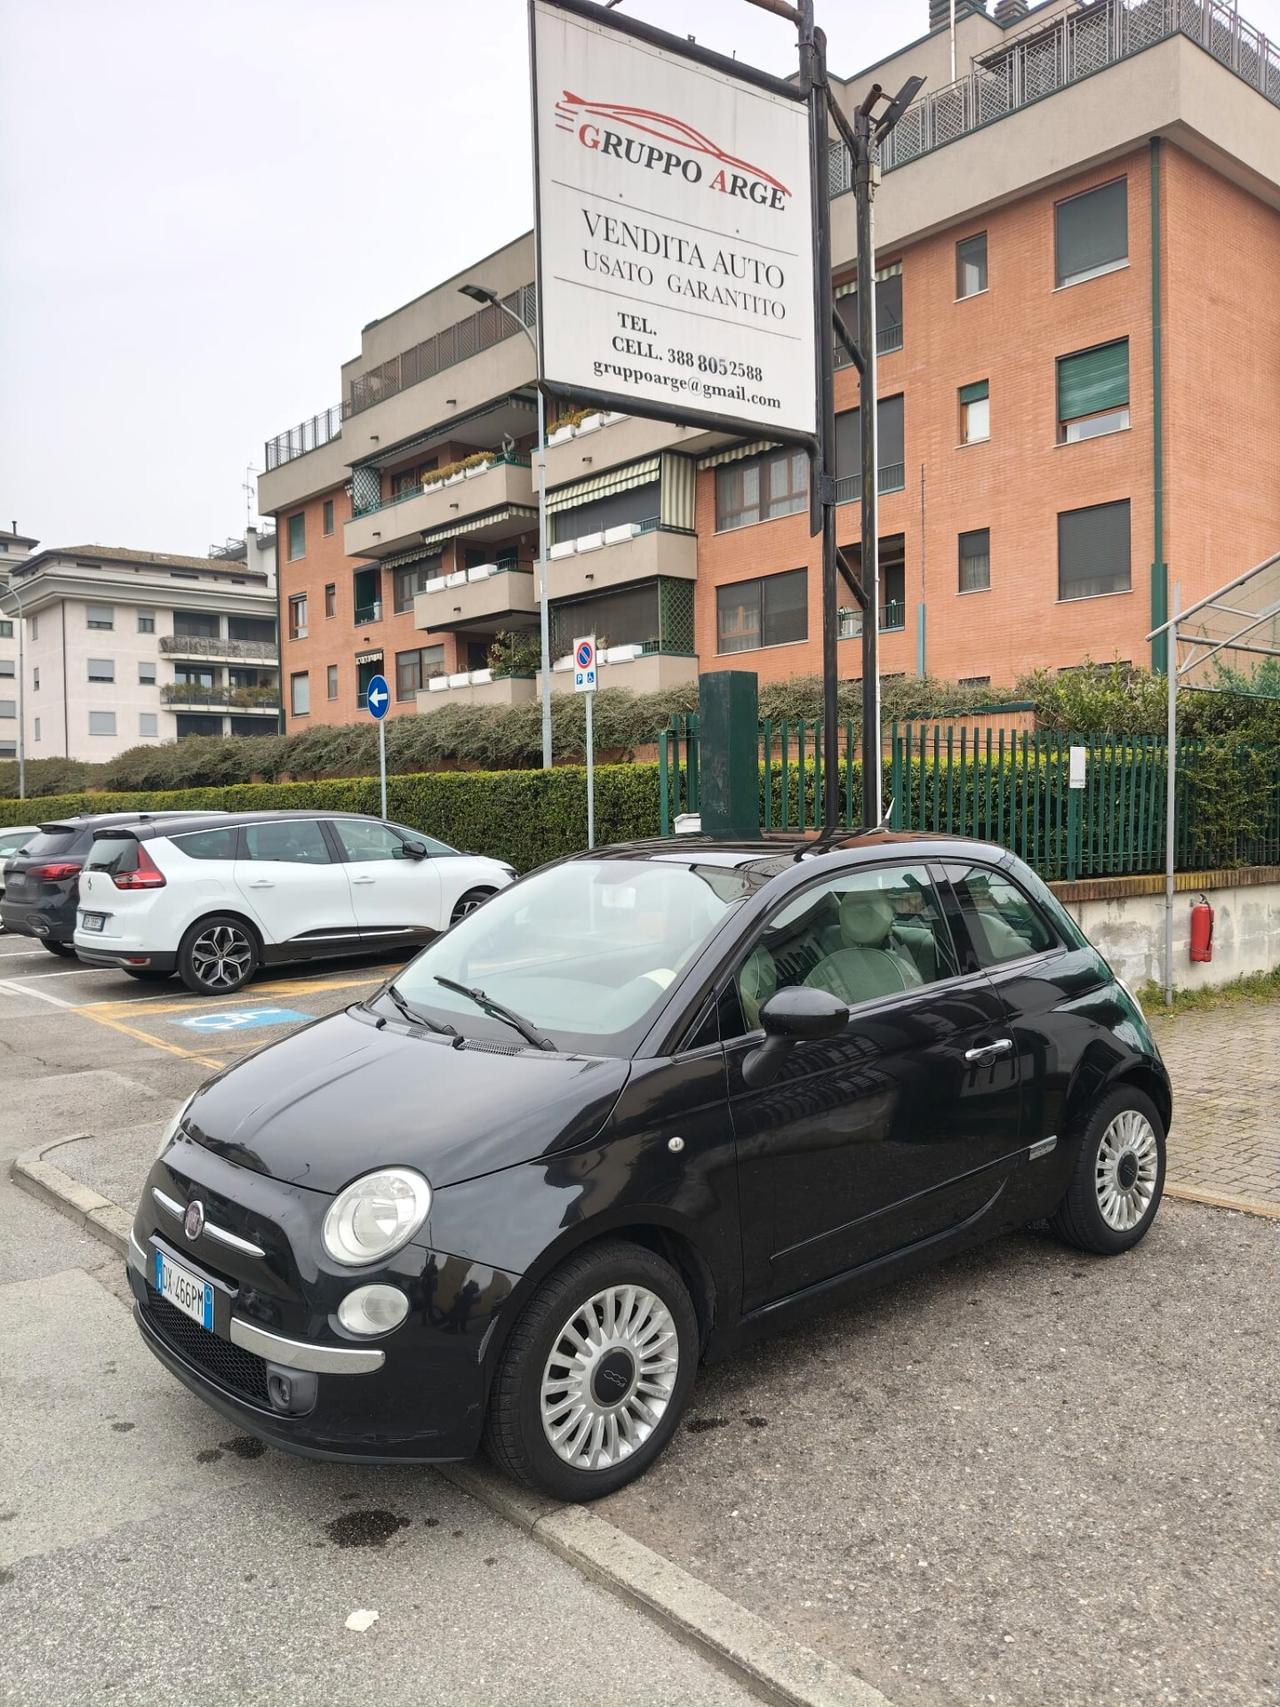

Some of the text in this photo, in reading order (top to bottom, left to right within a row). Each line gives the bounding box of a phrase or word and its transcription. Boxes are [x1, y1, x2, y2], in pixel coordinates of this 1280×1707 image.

[578, 122, 786, 211] GRUPPO ARGE
[581, 208, 785, 290] VENDITA AUTO
[582, 249, 786, 320] USATO GARANTITO
[611, 335, 663, 361] CELL.
[667, 347, 695, 368] 388
[617, 311, 658, 336] TEL.
[593, 359, 782, 409] gruppoarge@gmail.com
